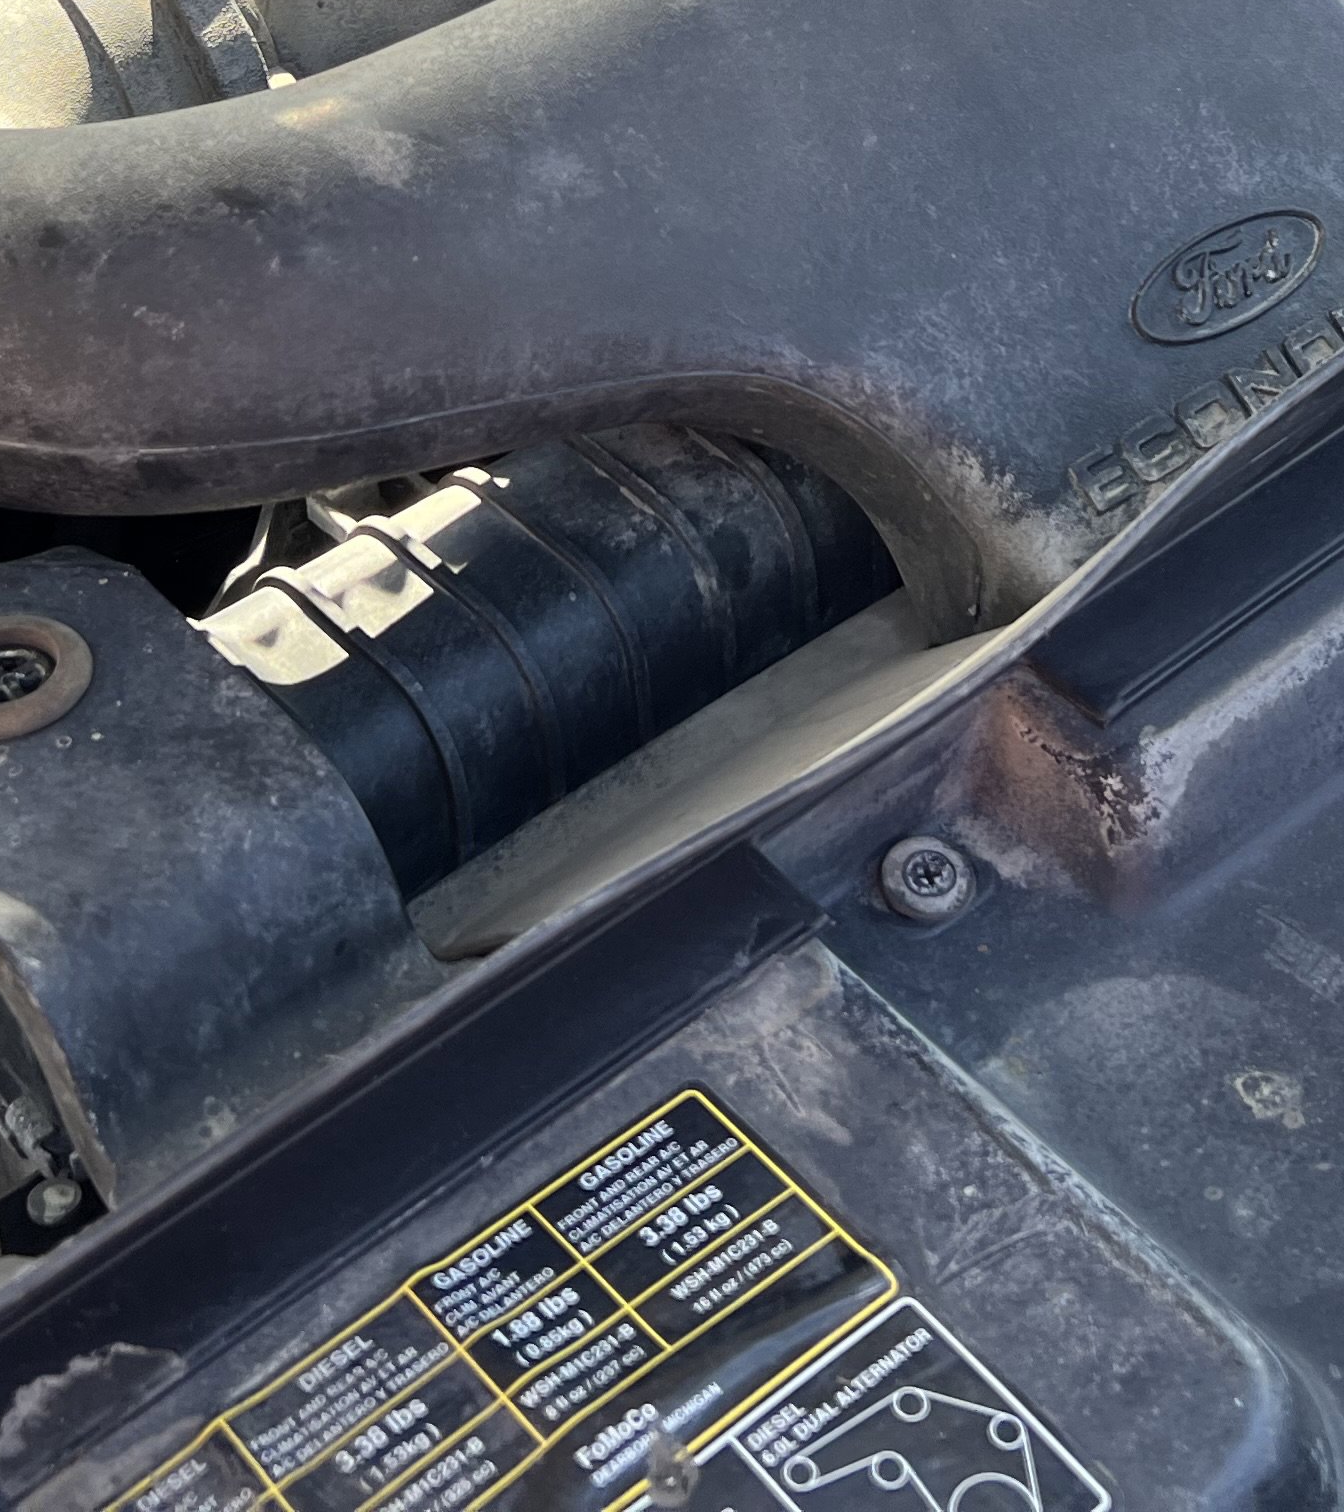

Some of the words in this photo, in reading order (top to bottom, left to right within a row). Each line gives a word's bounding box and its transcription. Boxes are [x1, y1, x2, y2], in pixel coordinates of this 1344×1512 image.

[1173, 228, 1296, 326] Ford
[556, 1196, 599, 1231] FRONT
[599, 1179, 626, 1202] AND
[624, 1155, 660, 1183] REAR
[659, 1141, 681, 1160] A/C
[579, 1119, 674, 1190] GASOLINE
[568, 1175, 658, 1242] CLIMATISATION
[656, 1163, 673, 1180] AV
[671, 1152, 690, 1169] ET
[689, 1140, 709, 1157] AR
[580, 1232, 602, 1252] A/C
[600, 1182, 674, 1237] DELANTERO
[671, 1174, 683, 1186] Y
[681, 1137, 738, 1178] TRASERO
[638, 1206, 689, 1247] 3.38
[683, 1184, 723, 1215] lbs
[432, 1218, 532, 1290] GASOLINE
[480, 1271, 521, 1304] AVANT
[670, 1219, 780, 1300] WSH-M1C231-B
[434, 1282, 477, 1314] FRONT
[478, 1267, 501, 1288] A/C
[456, 1315, 480, 1338] A/C
[478, 1266, 555, 1322] DELANTERO
[491, 1311, 543, 1347] 1.88
[537, 1287, 580, 1320] lbs
[298, 1335, 373, 1393] DIESEL
[791, 1402, 841, 1441] DUAL
[835, 1327, 933, 1407] ALTERNATOR
[298, 1394, 327, 1421] AND
[334, 1425, 389, 1473] 3.38
[384, 1398, 429, 1434] lbs
[575, 1403, 660, 1469] FoMoCo
[662, 1382, 723, 1432] MICHIGAN
[746, 1403, 807, 1451] DIESEL
[136, 1459, 207, 1512] DIESEL
[379, 1436, 484, 1512] H-M1C231-B
